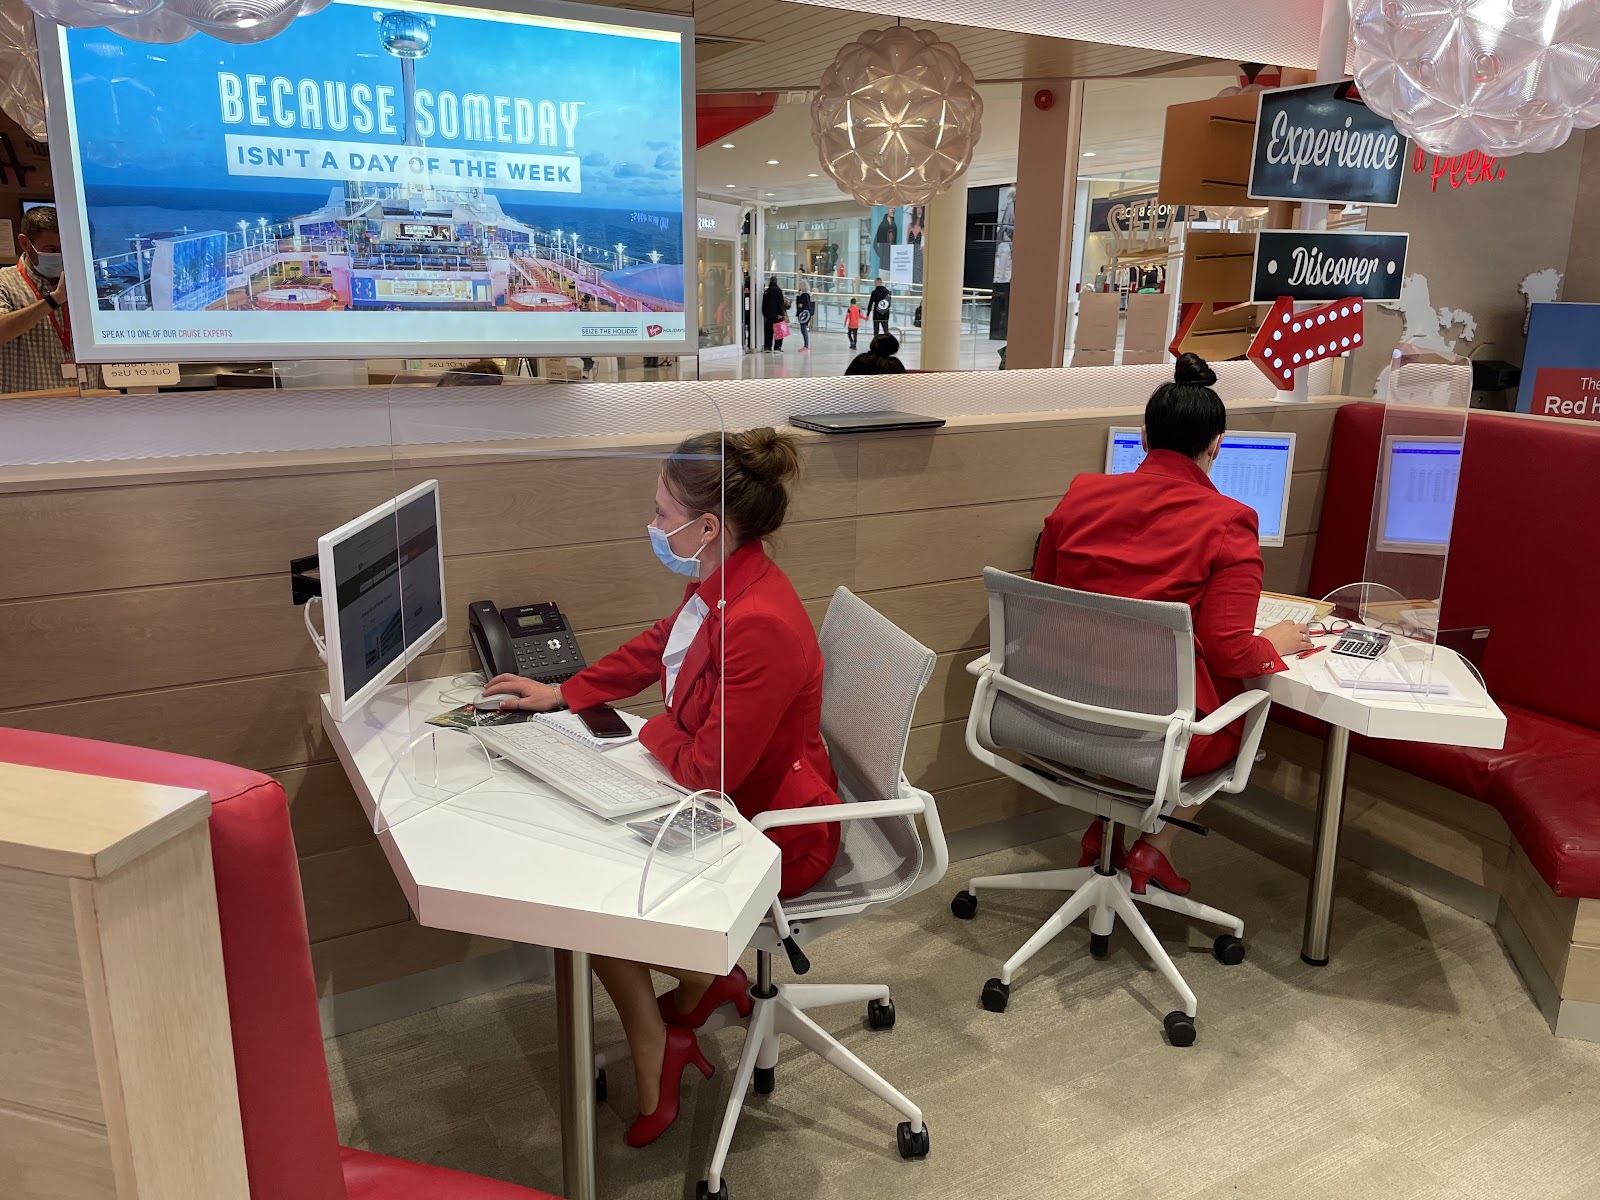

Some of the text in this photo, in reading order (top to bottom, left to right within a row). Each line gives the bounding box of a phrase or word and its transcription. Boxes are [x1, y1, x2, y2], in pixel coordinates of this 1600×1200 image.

[218, 72, 578, 148] BECAUSE SOMEDAY
[238, 146, 572, 183] ISN'T A DAY OF THE WEEK
[1266, 110, 1399, 184] Experience
[1431, 149, 1507, 192] peek
[1287, 247, 1379, 286] Discover
[102, 329, 233, 339] SPEAK TO ONE OF OUR CRUISE EXPERTS
[1581, 377, 1600, 391] The
[1544, 396, 1588, 415] Red
